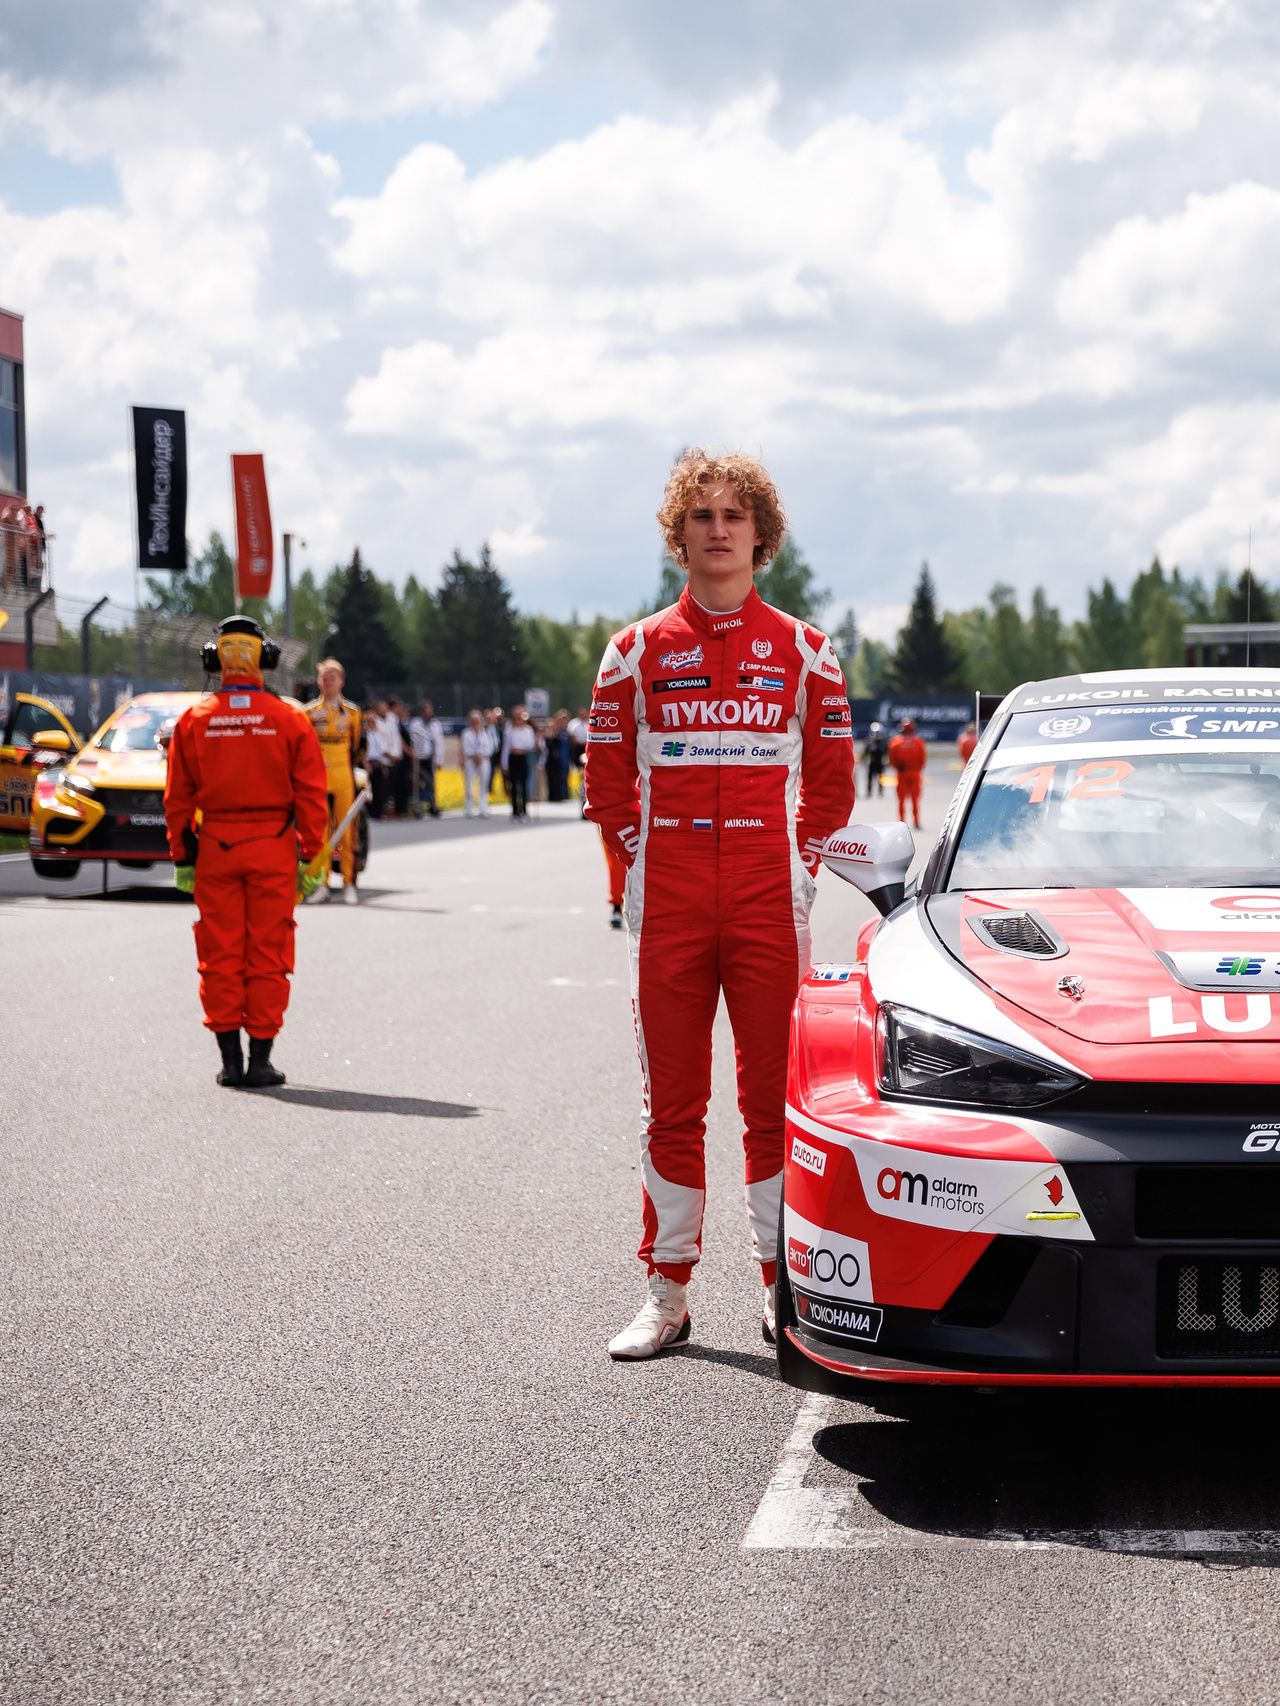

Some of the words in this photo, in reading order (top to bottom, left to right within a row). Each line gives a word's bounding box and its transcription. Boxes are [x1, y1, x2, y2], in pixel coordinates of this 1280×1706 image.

[713, 618, 743, 632] LUKOIL
[746, 663, 761, 671] SMP
[761, 665, 786, 674] RACING
[667, 679, 707, 689] YOKOHAMA
[762, 679, 784, 687] Russia
[1023, 689, 1150, 706] LUKOIL
[591, 701, 620, 711] NESIS
[661, 694, 783, 728] ЛУКОЙЛ
[1094, 705, 1218, 717] Российская
[209, 714, 265, 726] MOSCOW
[596, 716, 619, 728] 100
[1201, 719, 1279, 734] SMP
[252, 727, 277, 737] Team
[690, 745, 745, 757] Земский
[751, 746, 780, 757] банк
[1013, 760, 1133, 804] 12
[130, 813, 167, 826] YOKOHAM
[724, 818, 765, 828] MIKHAIL
[828, 839, 868, 857] LUKOIL
[793, 1143, 824, 1171] auto.ru
[877, 1166, 928, 1206] am
[932, 1177, 978, 1198] alarm
[930, 1194, 985, 1215] motors
[789, 1245, 807, 1268] ЭКТО
[807, 1246, 861, 1287] 100
[809, 1302, 871, 1332] YOKOHAMA
